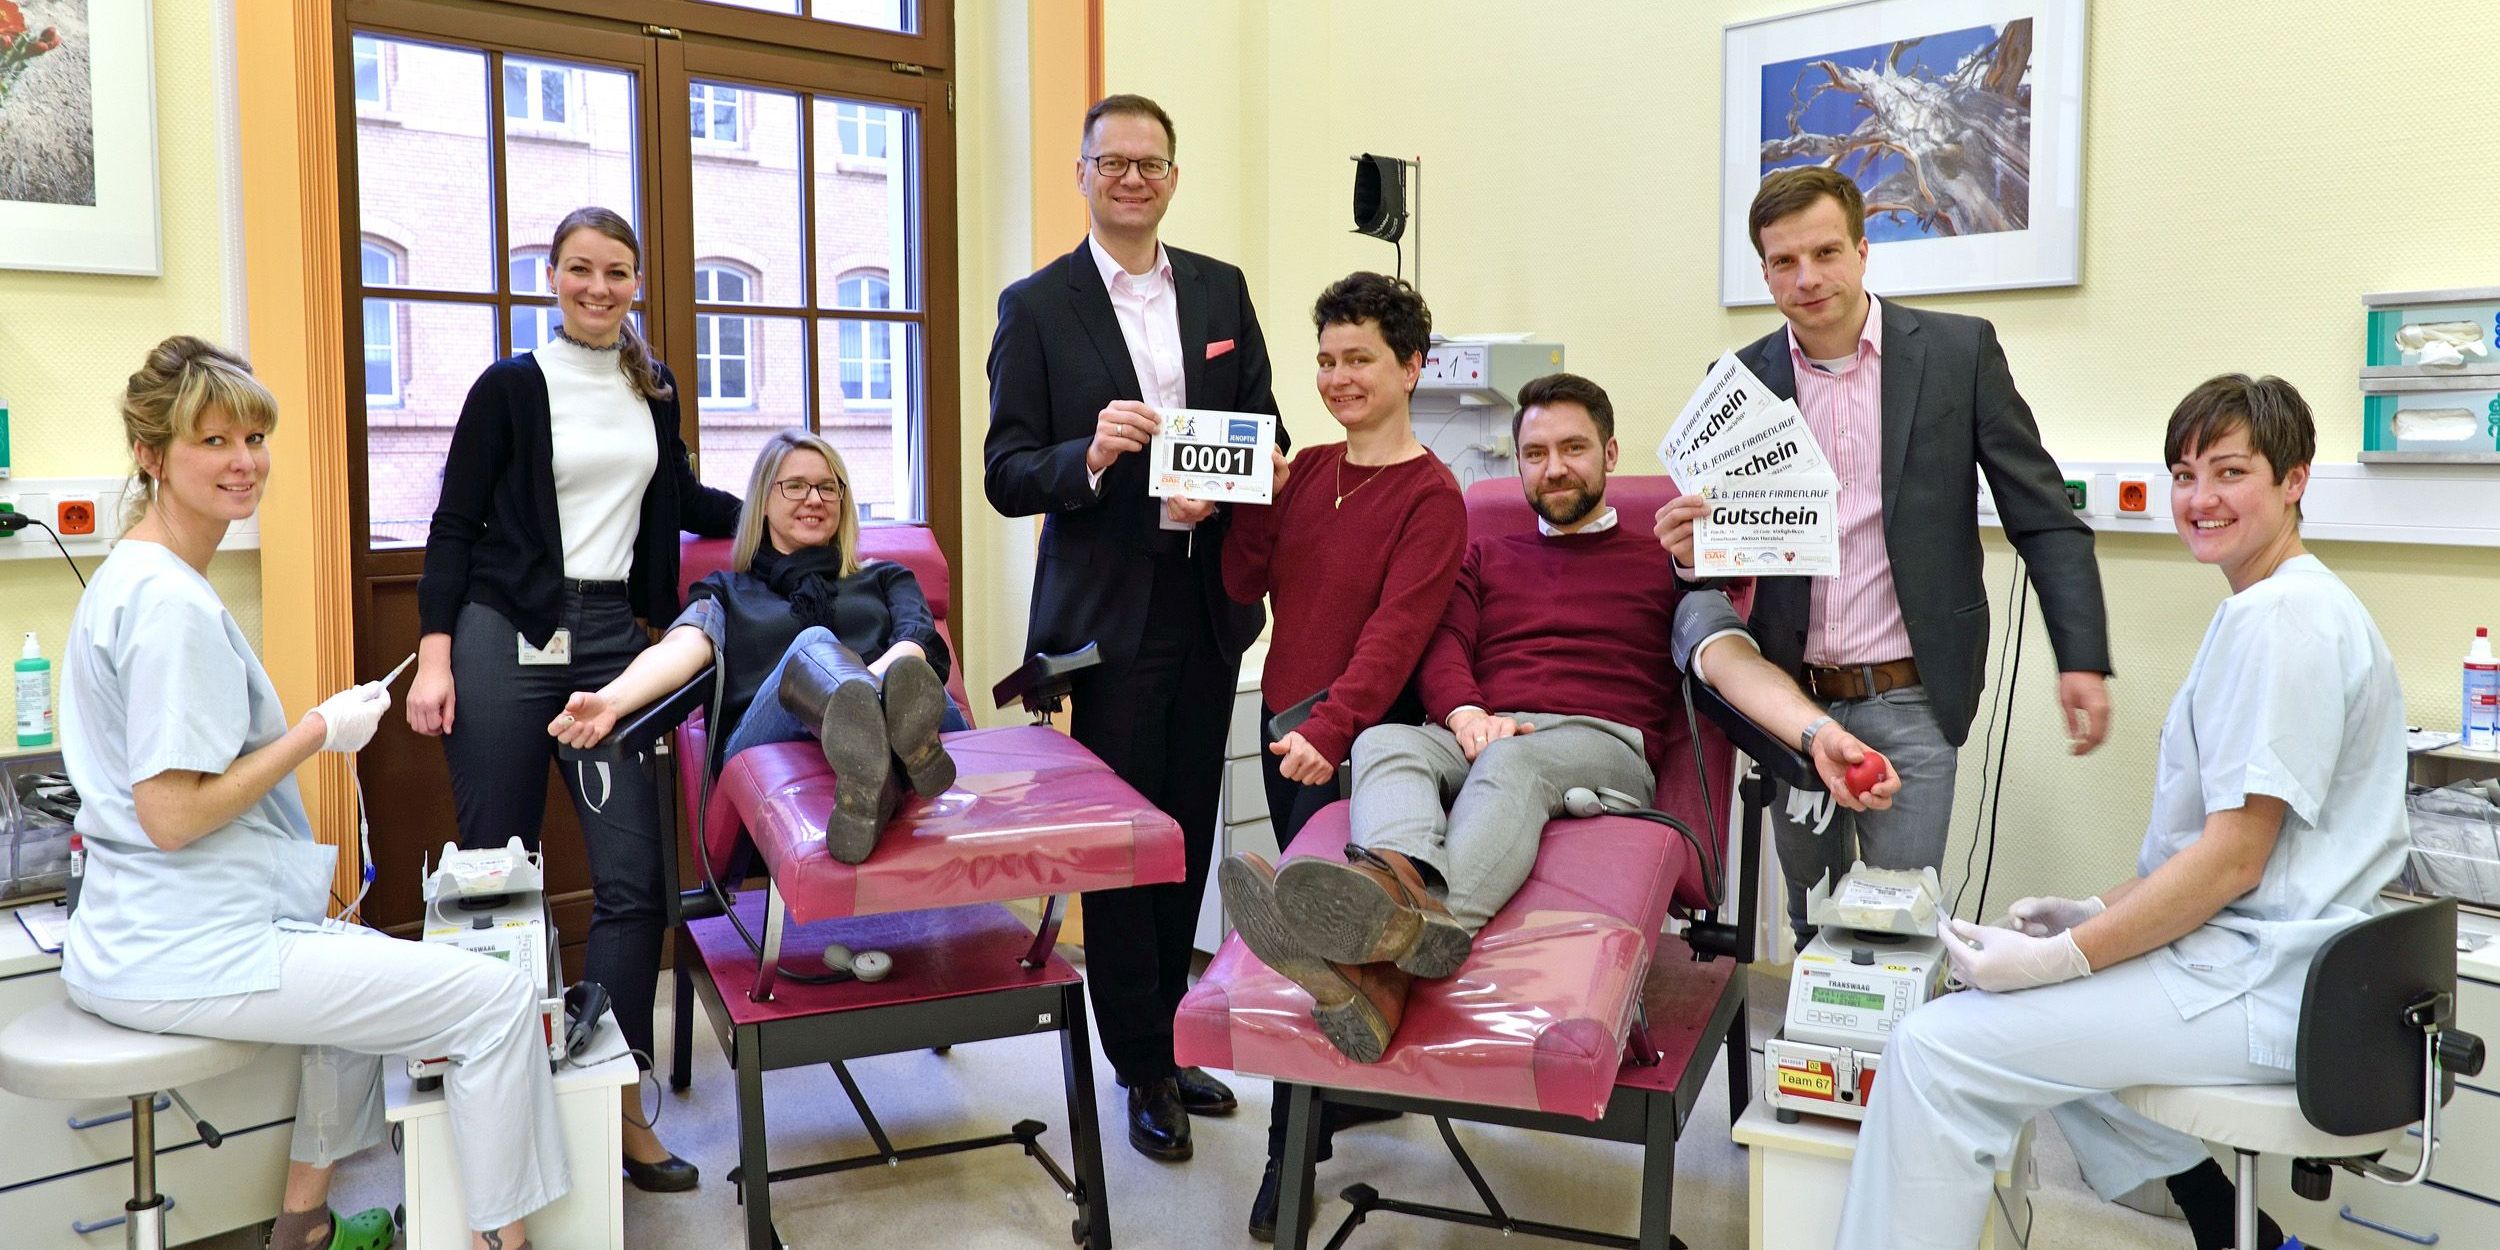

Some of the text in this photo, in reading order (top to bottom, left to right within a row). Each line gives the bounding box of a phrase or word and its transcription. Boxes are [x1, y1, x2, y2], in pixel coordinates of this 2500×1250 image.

[1700, 363, 1738, 413] FIRMENLAUF
[1680, 388, 1748, 460] tschein
[1230, 434, 1256, 443] JENOPTIK
[1710, 444, 1742, 468] JENAER
[1741, 415, 1797, 451] FIRMENLAUF
[1181, 445, 1246, 474] 0001
[1721, 489, 1830, 500] 8. JENAER FIRMENLAUF
[1712, 506, 1818, 525] Gutschein
[1828, 980, 1871, 991] TRANSWAAG
[1809, 1062, 1820, 1070] 02
[1780, 1071, 1830, 1089] Team 67
